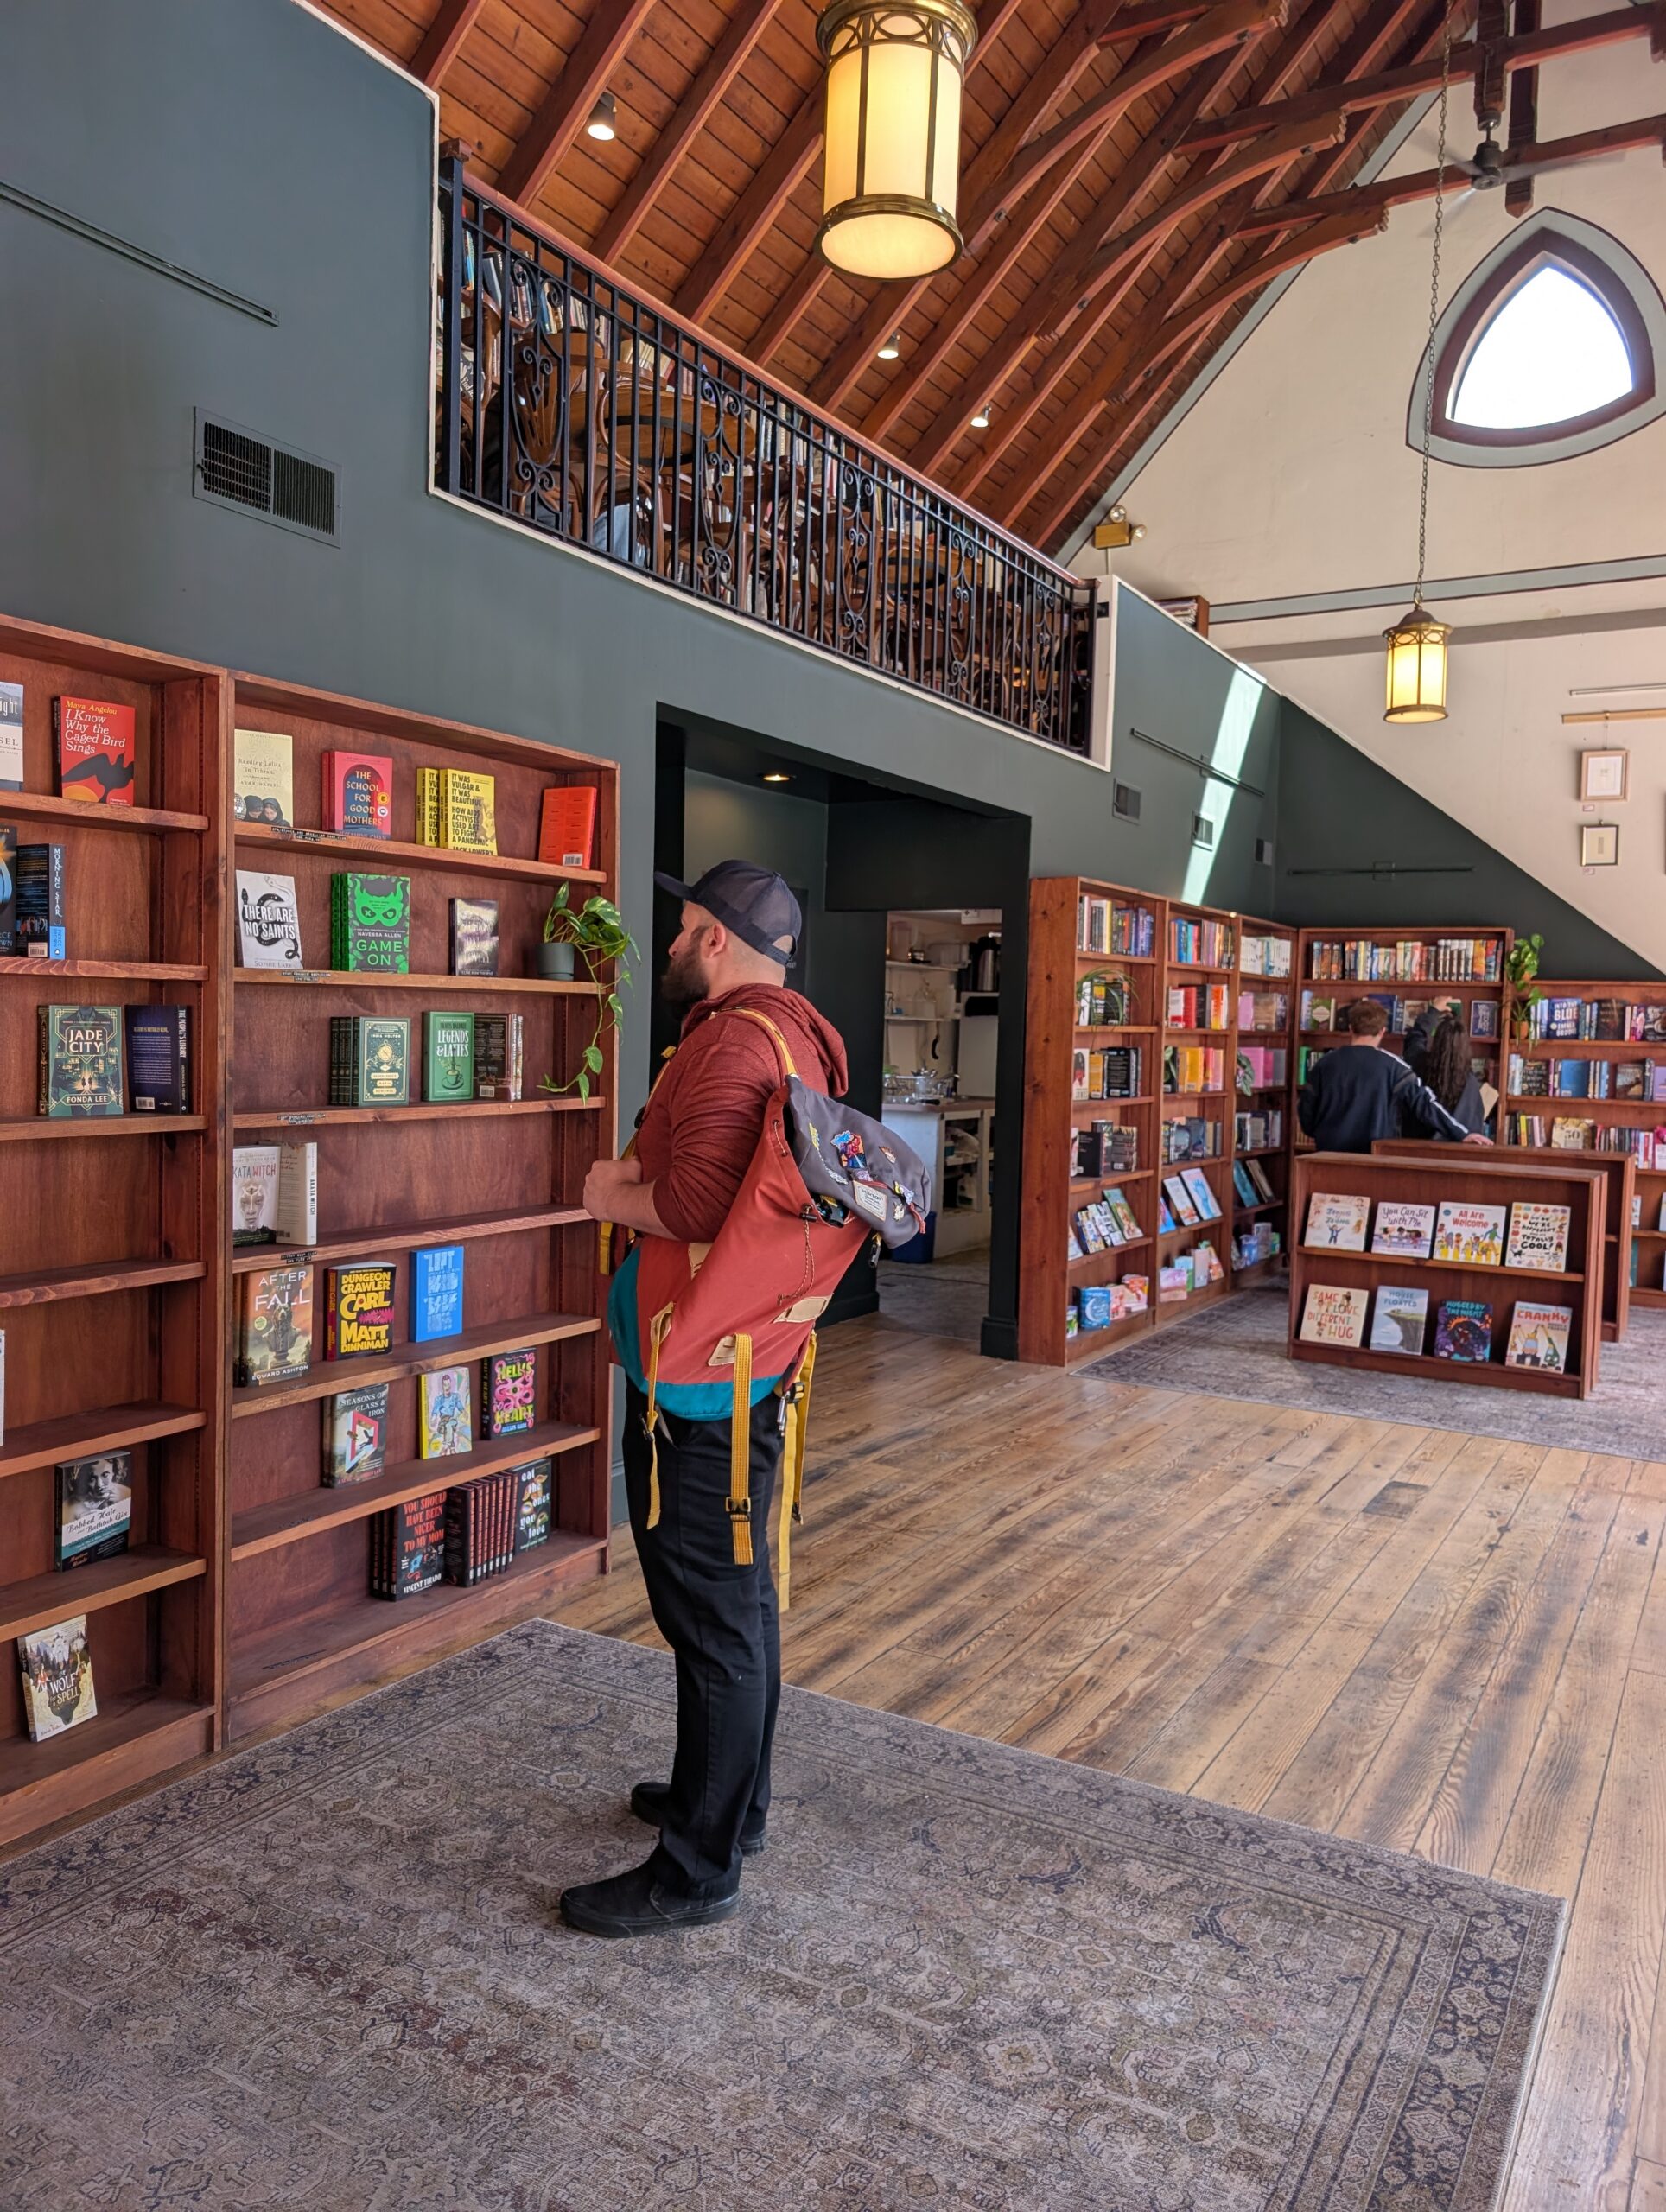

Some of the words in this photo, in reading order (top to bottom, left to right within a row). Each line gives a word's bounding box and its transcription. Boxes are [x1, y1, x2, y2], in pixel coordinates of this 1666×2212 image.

[0, 697, 18, 716] ight
[66, 701, 86, 710] Maya
[89, 704, 118, 715] Angelou
[66, 709, 71, 719] I
[74, 709, 105, 723] Know
[66, 719, 88, 733] Why
[93, 724, 109, 734] the
[0, 737, 18, 747] SEL
[65, 729, 99, 744] Caged
[102, 734, 125, 748] Bird
[66, 741, 95, 755] Sings
[356, 771, 372, 779] THE
[458, 774, 470, 783] WAS
[346, 781, 380, 792] SCHOOL
[452, 781, 474, 791] VULGAR
[354, 793, 372, 802] FOR
[452, 796, 482, 807] BEAUTIFUL
[350, 804, 375, 814] GOOD
[344, 815, 382, 826] MOTHERS
[452, 814, 480, 824] ACTIVISTS
[452, 821, 467, 830] USED
[458, 836, 489, 847] PANDEMIC
[468, 847, 493, 855] LOWERY
[54, 848, 62, 888] MORNING
[244, 904, 273, 921] THERE
[277, 907, 294, 923] ARE
[245, 921, 259, 937] NO
[261, 923, 296, 939] SAINTS
[356, 939, 403, 952] GAME
[368, 954, 391, 966] ON
[1555, 1007, 1578, 1020] BLUE
[69, 1030, 104, 1042] JADE
[437, 1030, 468, 1044] LEGENDS
[69, 1042, 104, 1054] CITY
[436, 1046, 444, 1056] &
[444, 1044, 468, 1058] LATTES
[233, 1166, 252, 1179] KATA
[252, 1163, 277, 1179] WITCH
[1383, 1208, 1398, 1219] You
[1400, 1206, 1415, 1217] Can
[1416, 1209, 1428, 1218] Sit
[1459, 1210, 1468, 1218] All
[1408, 1218, 1421, 1227] Me
[1521, 1234, 1554, 1243] TOTALLY
[1521, 1242, 1554, 1250] COOL!
[259, 1270, 306, 1287] AFTER
[342, 1272, 391, 1284] DUNGEON
[340, 1281, 391, 1294] CRAWLER
[255, 1289, 311, 1311] FALL
[1313, 1291, 1339, 1303] SAME
[1384, 1298, 1417, 1308] FLOATED
[340, 1291, 391, 1320] CARL
[1333, 1303, 1359, 1314] LOVE
[1307, 1312, 1351, 1325] DIFFERENT
[1517, 1310, 1569, 1324] CRANKY
[340, 1320, 389, 1344] MATT
[1328, 1325, 1353, 1339] HUG
[340, 1339, 389, 1353] DINNIMAN
[252, 1370, 280, 1381] EDWARD
[282, 1365, 308, 1375] ASHTON
[340, 1393, 375, 1407] SEASONS
[356, 1402, 378, 1412] GLASS
[368, 1408, 385, 1417] IRON
[494, 1405, 534, 1424] HEART
[522, 1468, 535, 1482] eat
[404, 1500, 419, 1514] YOU
[420, 1491, 447, 1507] SHOULD
[532, 1493, 550, 1507] ones
[67, 1516, 95, 1533] Bobbed
[99, 1509, 117, 1520] Hair
[406, 1510, 423, 1528] HAVE
[425, 1505, 442, 1521] BEEN
[520, 1514, 536, 1530] you
[86, 1519, 112, 1533] Bathtub
[415, 1521, 436, 1535] NICER
[529, 1524, 545, 1538] love
[404, 1540, 415, 1553] TO
[416, 1536, 427, 1548] MY
[429, 1529, 444, 1543] MOM
[403, 1580, 423, 1593] VINCENT
[423, 1573, 441, 1586] TIRADO
[50, 1673, 76, 1695] WOLF
[57, 1687, 79, 1704] SPELL
